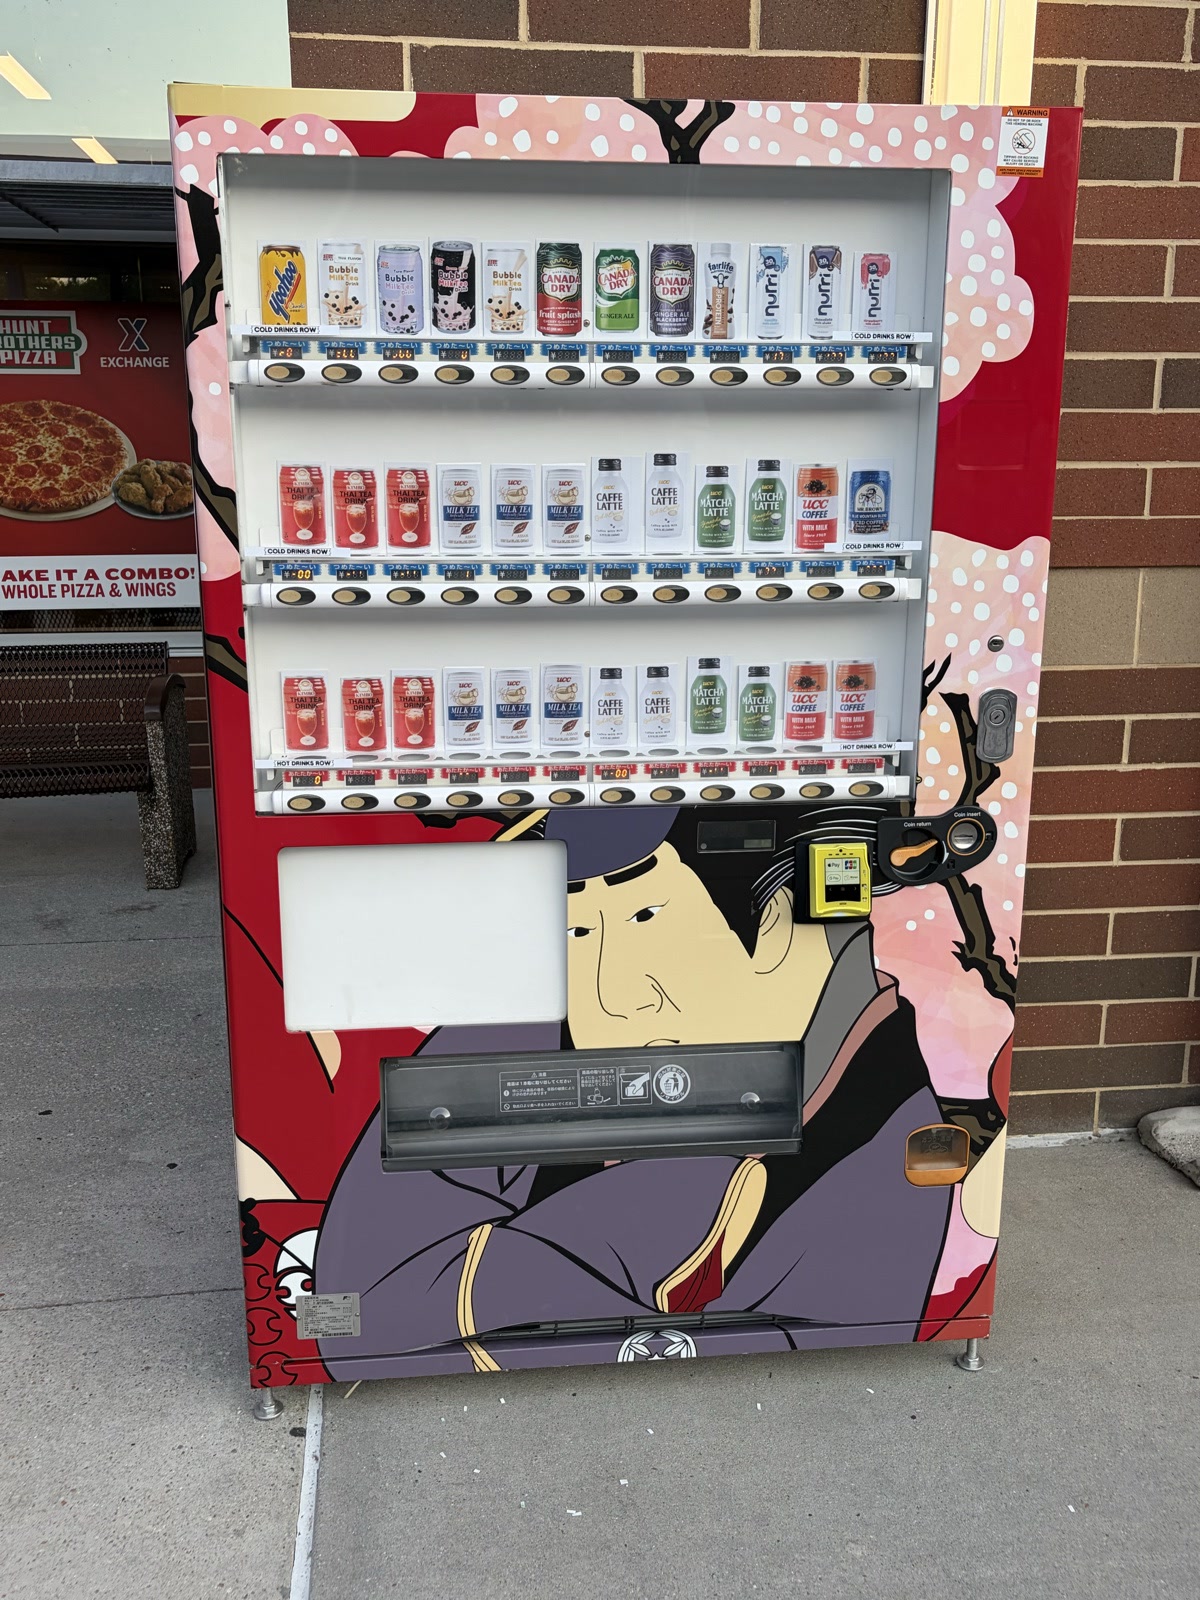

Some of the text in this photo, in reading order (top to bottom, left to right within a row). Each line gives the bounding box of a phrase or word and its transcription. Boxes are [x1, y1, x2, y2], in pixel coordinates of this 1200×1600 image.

[328, 265, 359, 274] Bubble
[708, 262, 734, 272] fairlife
[385, 273, 414, 282] Bubble
[438, 270, 469, 280] Bubble
[492, 271, 522, 279] Bubble
[541, 273, 581, 284] CANADA
[597, 268, 636, 284] CANADA
[609, 278, 629, 291] DRY
[653, 275, 693, 286] CANADA
[550, 284, 572, 293] DRY
[662, 286, 684, 295] DRY
[765, 273, 780, 317] nurri
[817, 273, 833, 316] nurri
[868, 278, 882, 318] nurri
[540, 309, 581, 320] fruit splash
[0, 320, 52, 335] HUNT
[0, 336, 76, 350] OTHERS
[1, 350, 57, 365] PIZZA
[100, 357, 170, 368] EXCHANGE
[651, 487, 678, 496] CAFFE
[596, 492, 623, 502] CAFFE
[651, 496, 678, 506] LATTE
[700, 497, 733, 507] MATCHA
[751, 492, 784, 502] MATCHA
[596, 502, 623, 510] LATTE
[754, 502, 780, 510] LATTE
[802, 499, 830, 510] UCC
[446, 506, 479, 514] MILK TEA
[499, 506, 532, 514] MILK TEA
[550, 506, 583, 514] MILK TEA
[703, 508, 728, 517] LATTE
[802, 510, 828, 518] COFFEE
[1, 567, 195, 582] AKE IT A COMBO!
[1, 582, 177, 600] WHOLE PIZZA & WINGS
[693, 688, 724, 697] MATCHA
[644, 697, 670, 706] CAFFE
[696, 696, 720, 706] LATTE
[742, 696, 774, 704] MATCHA
[792, 693, 818, 704] UCC
[840, 693, 867, 703] UCC
[499, 704, 530, 712] MILK TEA
[548, 703, 582, 712] MILK TEA
[598, 699, 624, 708] CAFFE
[791, 704, 818, 712] COFFEE
[840, 702, 866, 712] COFFEE
[470, 706, 482, 714] TEA
[598, 708, 624, 716] LATTE
[645, 706, 670, 714] LATTE
[744, 704, 770, 714] LATTE
